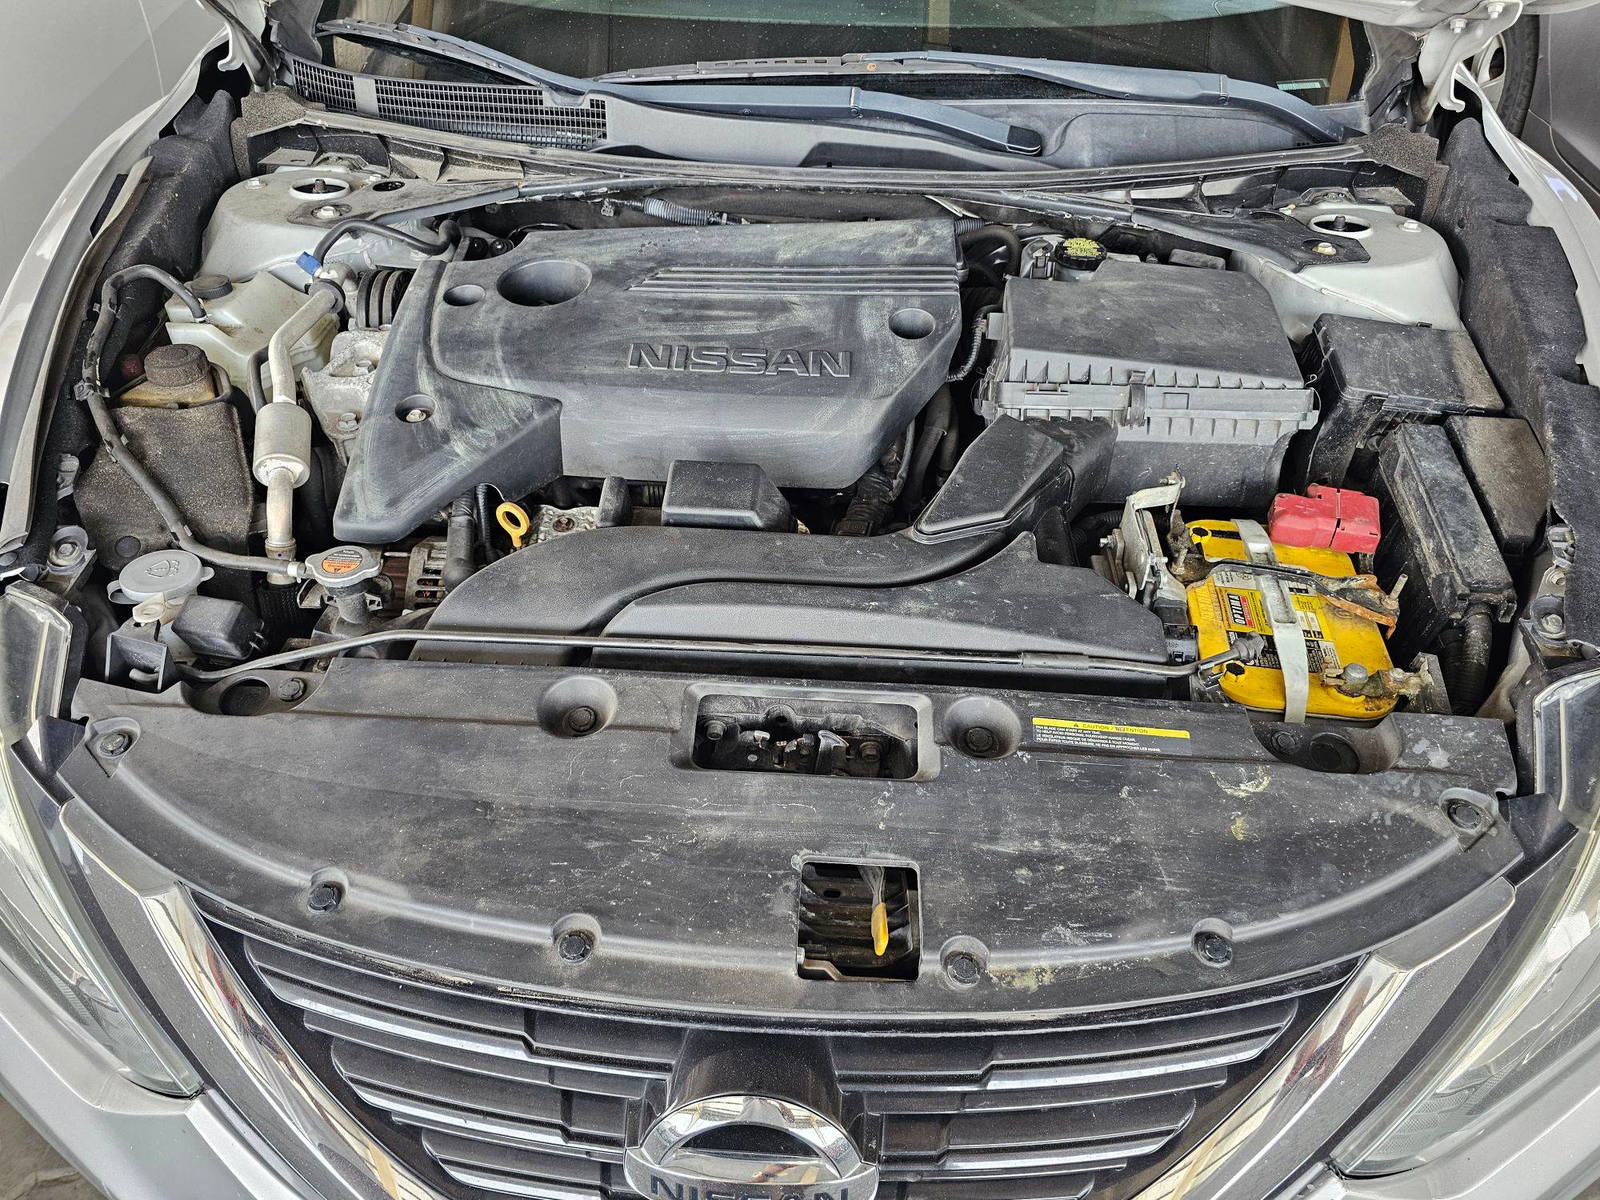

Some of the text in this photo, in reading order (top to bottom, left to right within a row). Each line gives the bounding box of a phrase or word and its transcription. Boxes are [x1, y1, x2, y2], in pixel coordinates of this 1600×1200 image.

[628, 342, 852, 378] NISSAN
[1228, 594, 1246, 625] OPTIMA
[1115, 726, 1148, 734] TENTION
